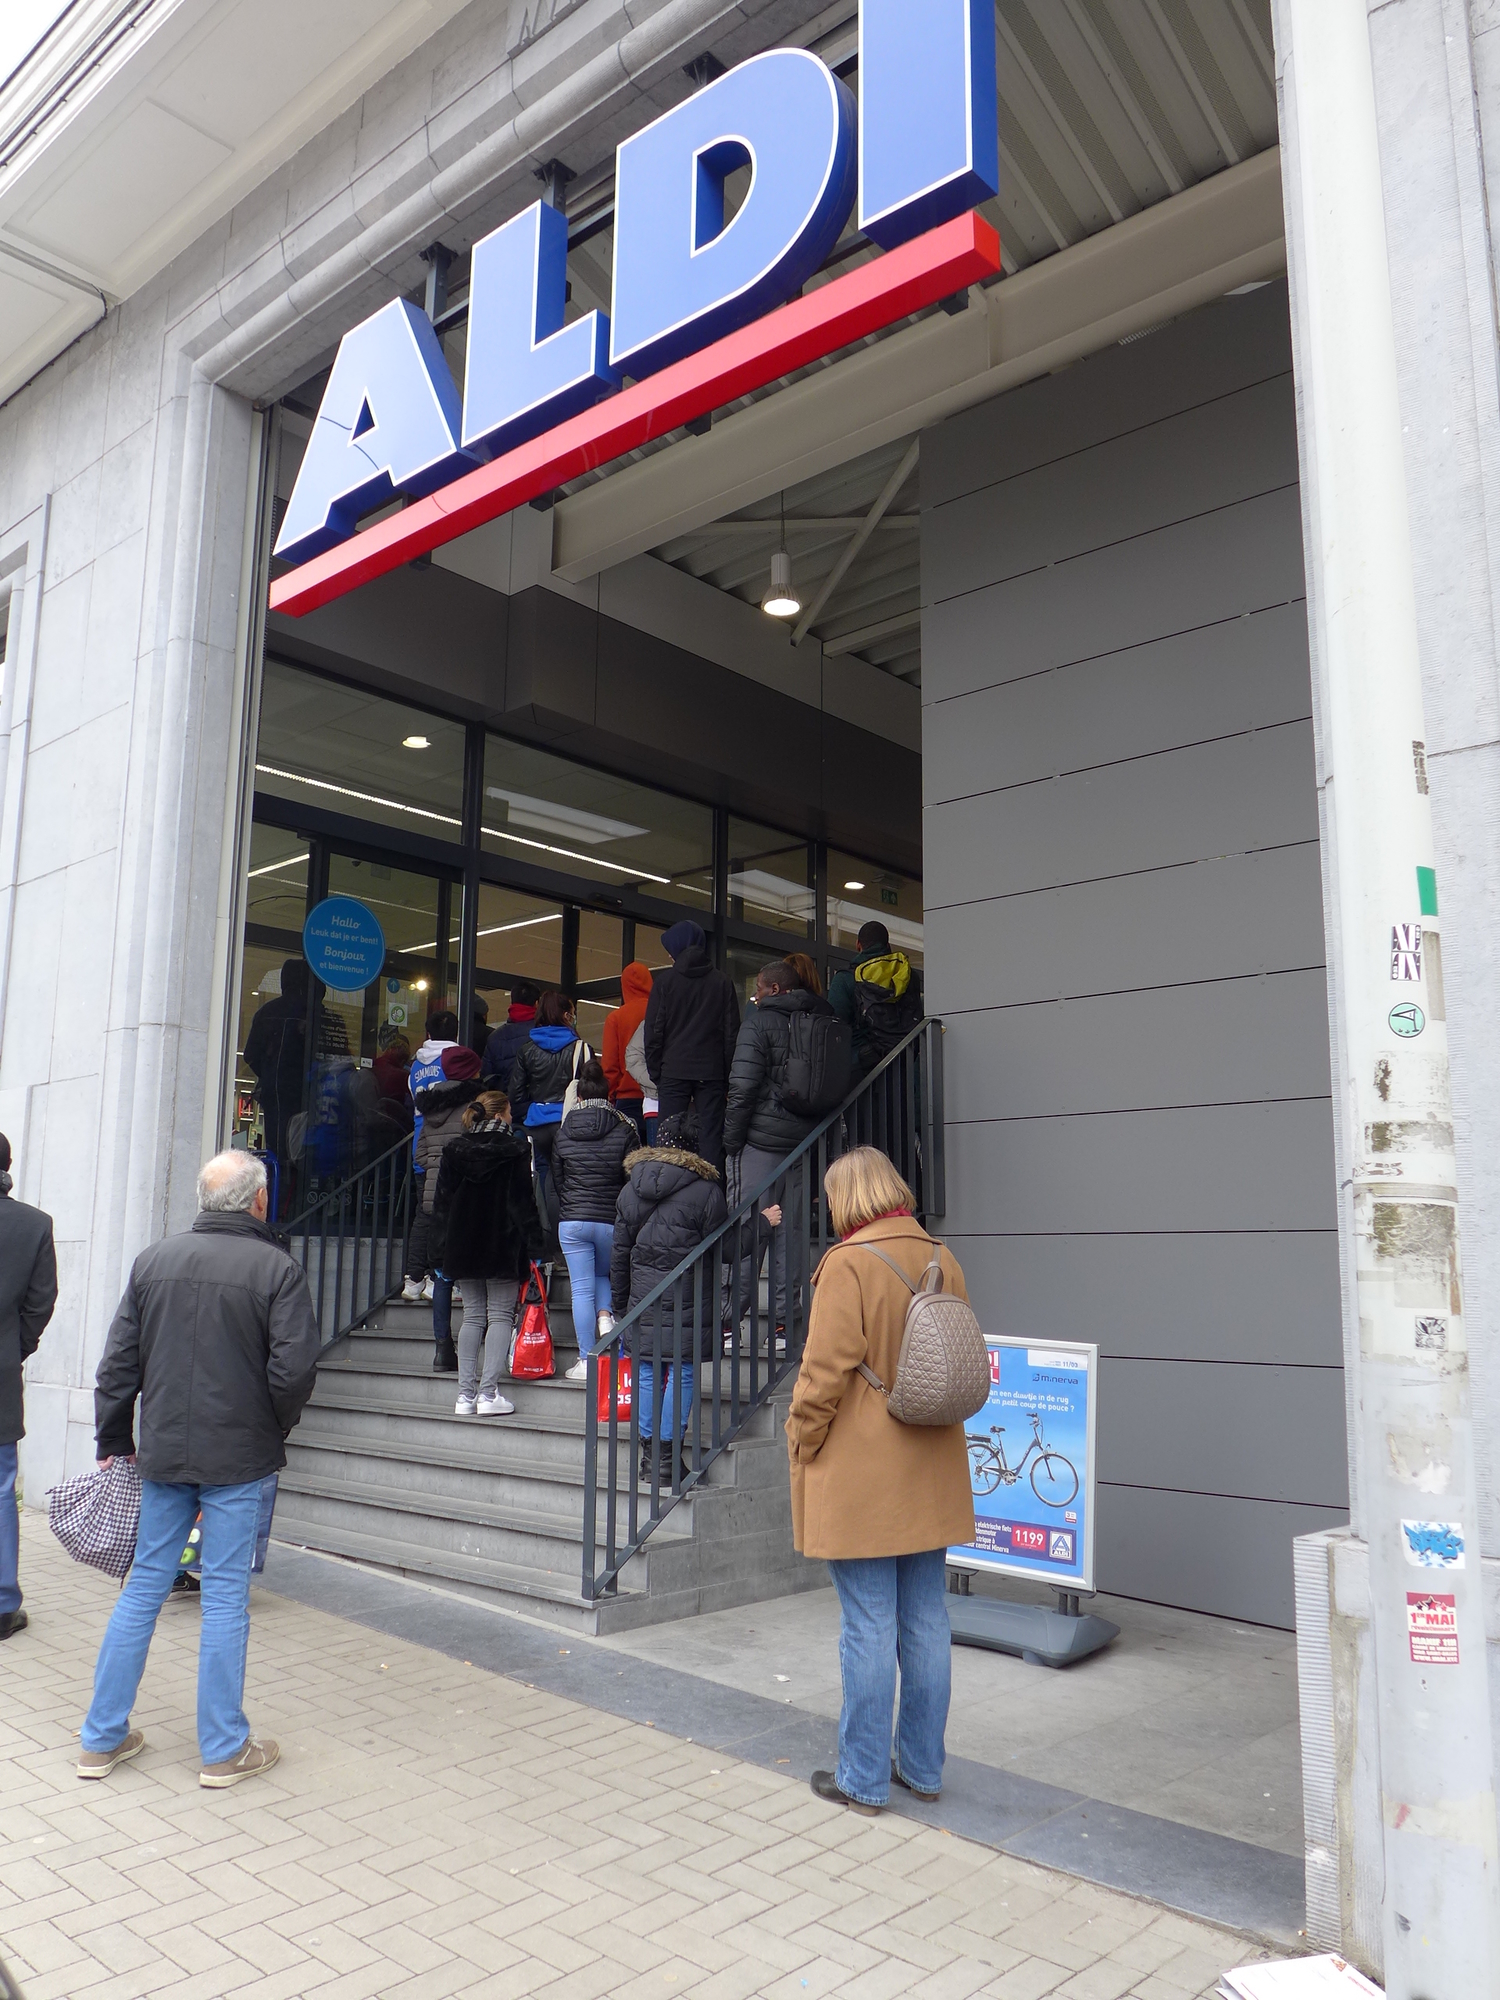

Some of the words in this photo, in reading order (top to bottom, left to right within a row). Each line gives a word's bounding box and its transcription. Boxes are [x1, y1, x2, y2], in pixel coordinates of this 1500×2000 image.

[273, 0, 990, 563] ALDI
[331, 915, 361, 929] Hallo
[310, 927, 329, 938] Leuk
[330, 930, 342, 939] dat
[342, 932, 350, 942] je
[351, 934, 359, 942] er
[360, 935, 378, 945] bent!
[324, 945, 366, 961] Bonjour
[319, 961, 327, 969] et
[328, 962, 365, 975] bienvenue
[414, 1065, 441, 1083] SIMMONS
[1013, 1391, 1037, 1401] duwtje
[1038, 1393, 1045, 1401] in
[1046, 1394, 1055, 1402] de
[1056, 1396, 1069, 1405] rug
[1001, 1399, 1018, 1407] petit
[1020, 1401, 1036, 1409] coup
[1038, 1402, 1047, 1410] de
[1048, 1404, 1069, 1412] pouce
[1070, 1405, 1075, 1413] ?
[1015, 1529, 1044, 1546] 1199
[992, 1544, 1010, 1554] Minerva
[1426, 1613, 1454, 1625] MAI
